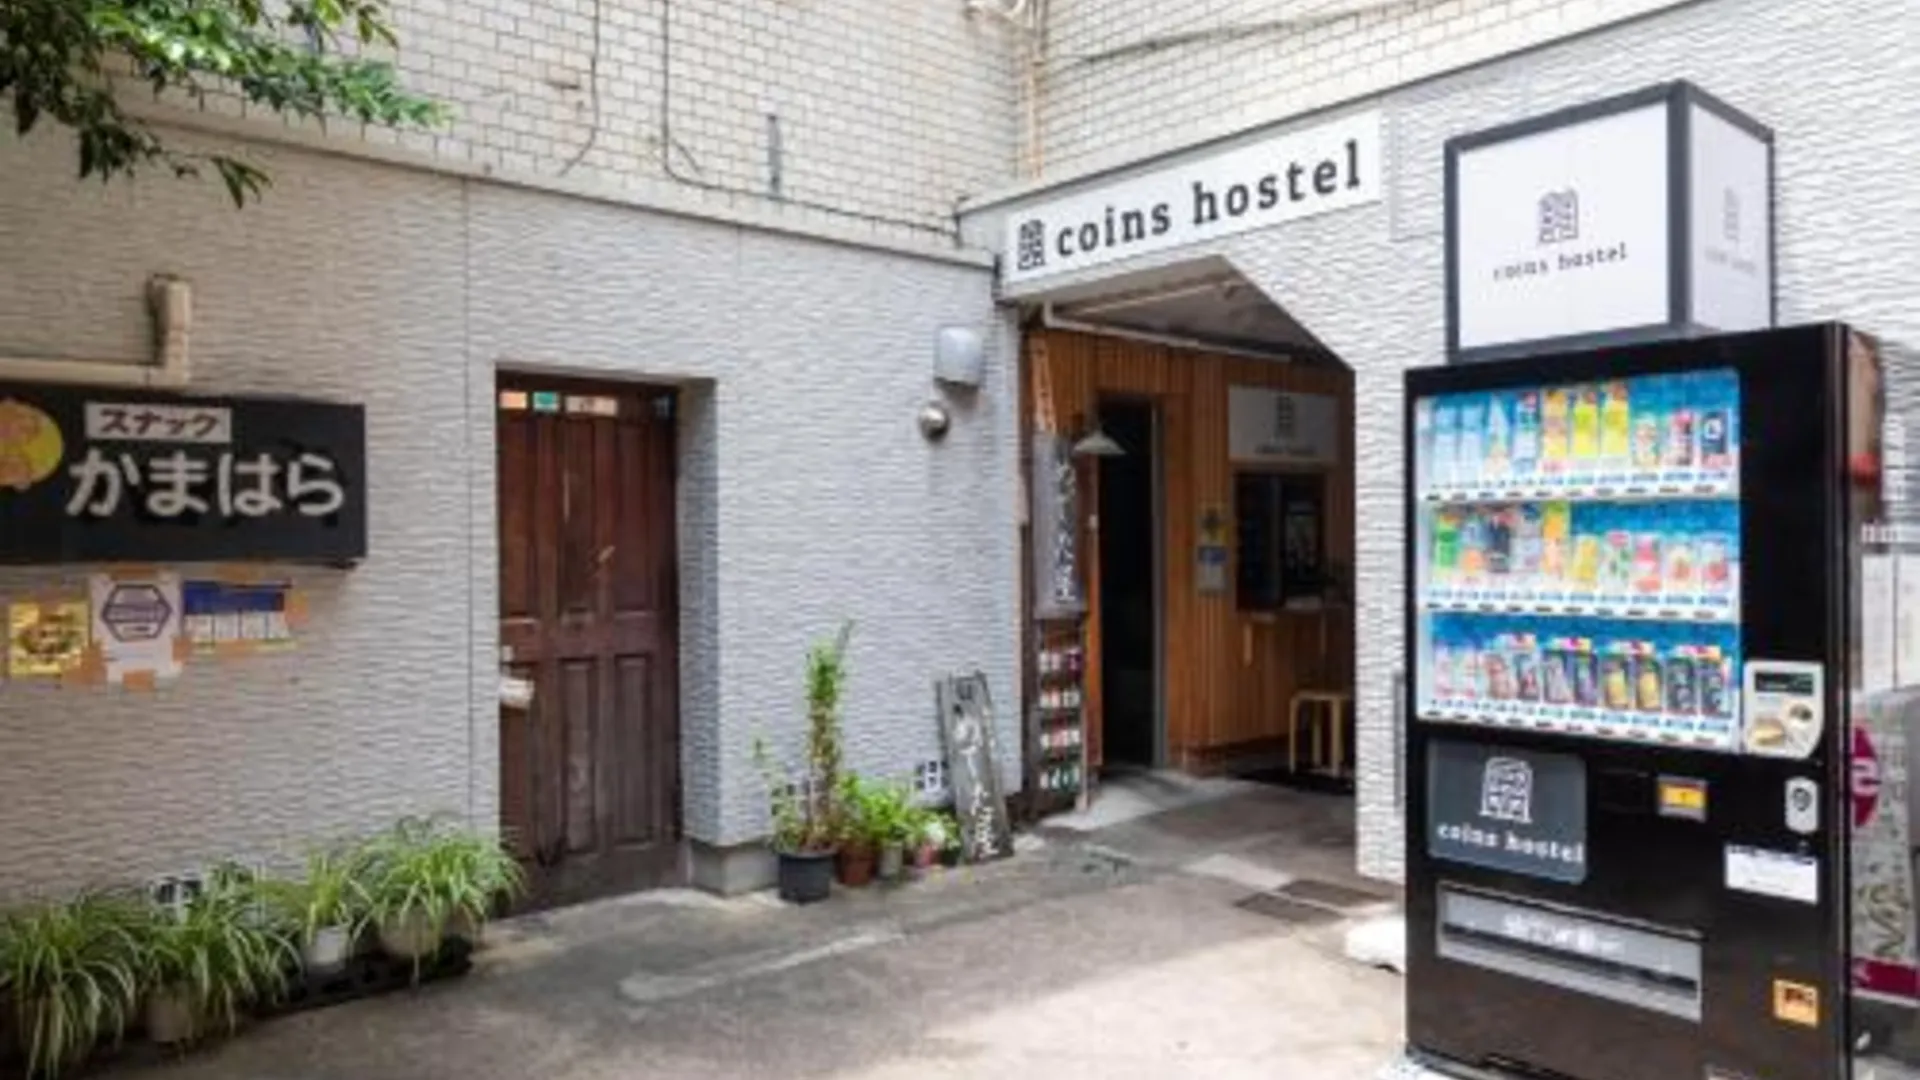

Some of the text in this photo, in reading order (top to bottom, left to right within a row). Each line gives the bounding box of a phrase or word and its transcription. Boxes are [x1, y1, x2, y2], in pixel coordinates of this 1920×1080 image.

[1056, 138, 1361, 257] coins hostel
[1558, 240, 1627, 271] hostel
[100, 408, 219, 437] スナック
[66, 449, 344, 516] かまはら
[1436, 820, 1584, 864] coins hostel
